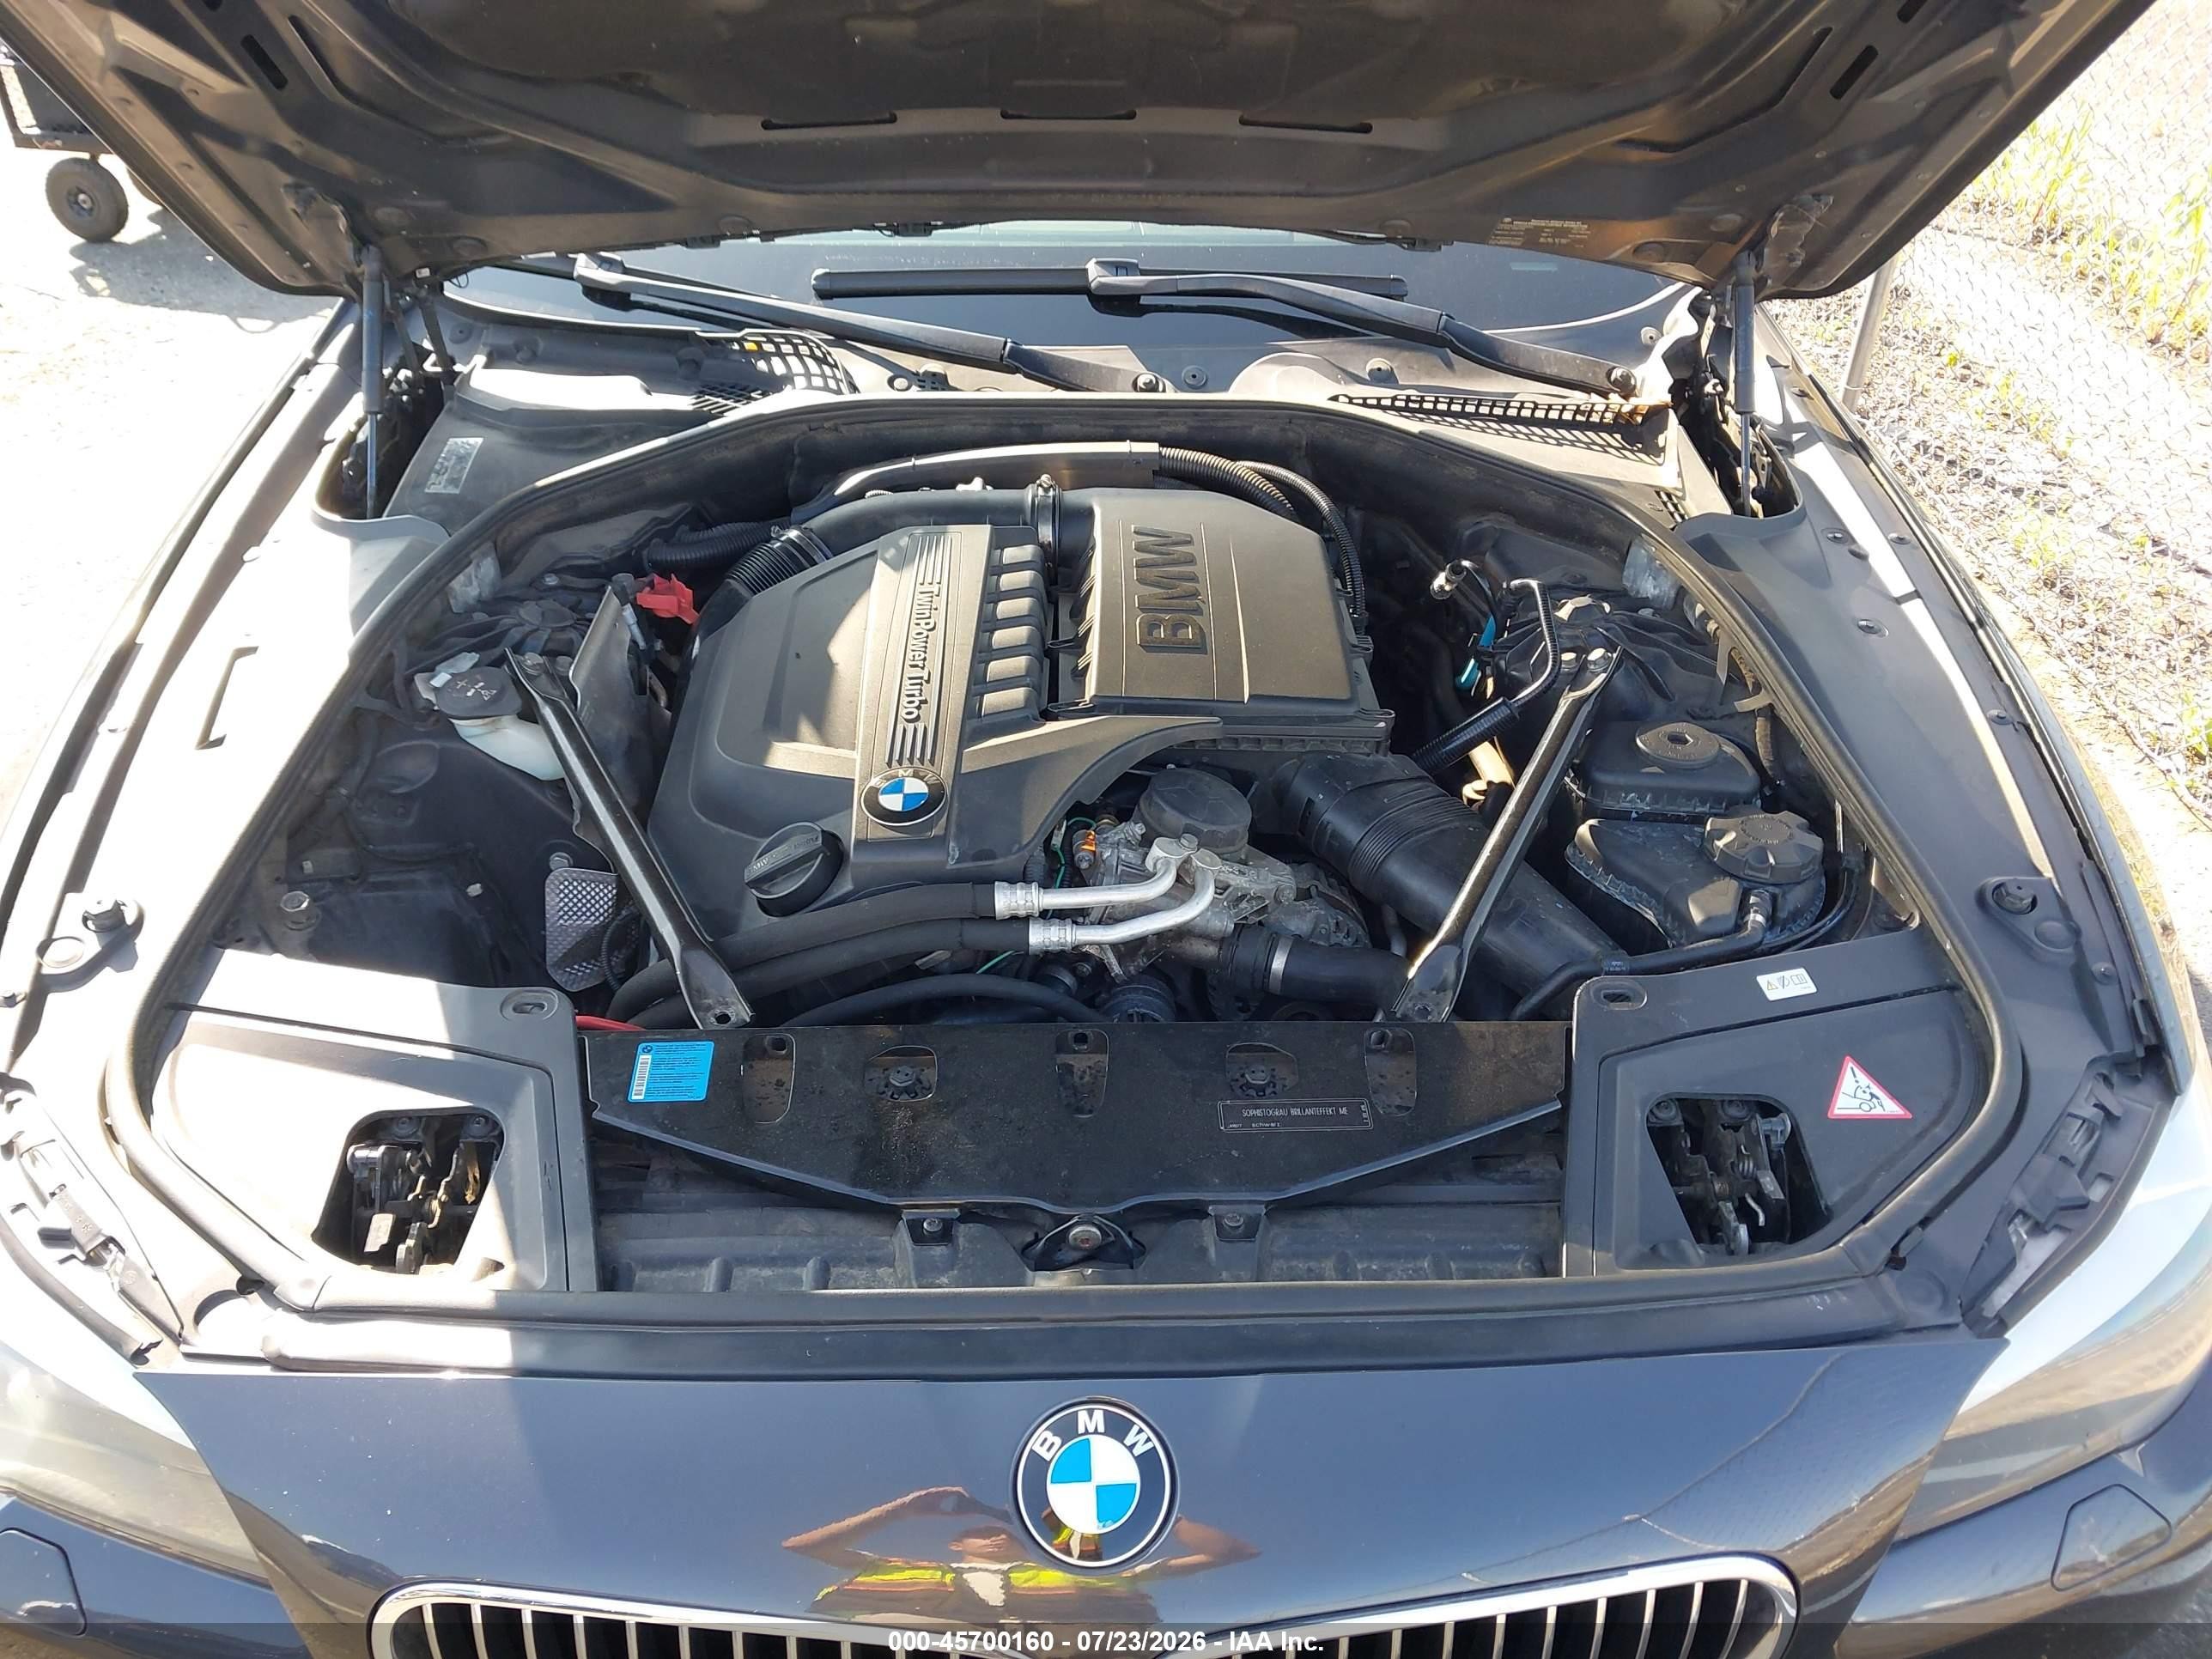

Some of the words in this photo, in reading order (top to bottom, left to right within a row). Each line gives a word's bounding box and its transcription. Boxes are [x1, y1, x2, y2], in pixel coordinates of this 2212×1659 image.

[1132, 525, 1207, 654] BMW
[908, 585, 940, 669] TwinPower
[901, 666, 931, 723] Turbo
[1242, 1108, 1288, 1117] SOPHISTOGRAU
[1290, 1106, 1336, 1116] BRILLANTEFFEKT
[1031, 1409, 1154, 1462] BMW
